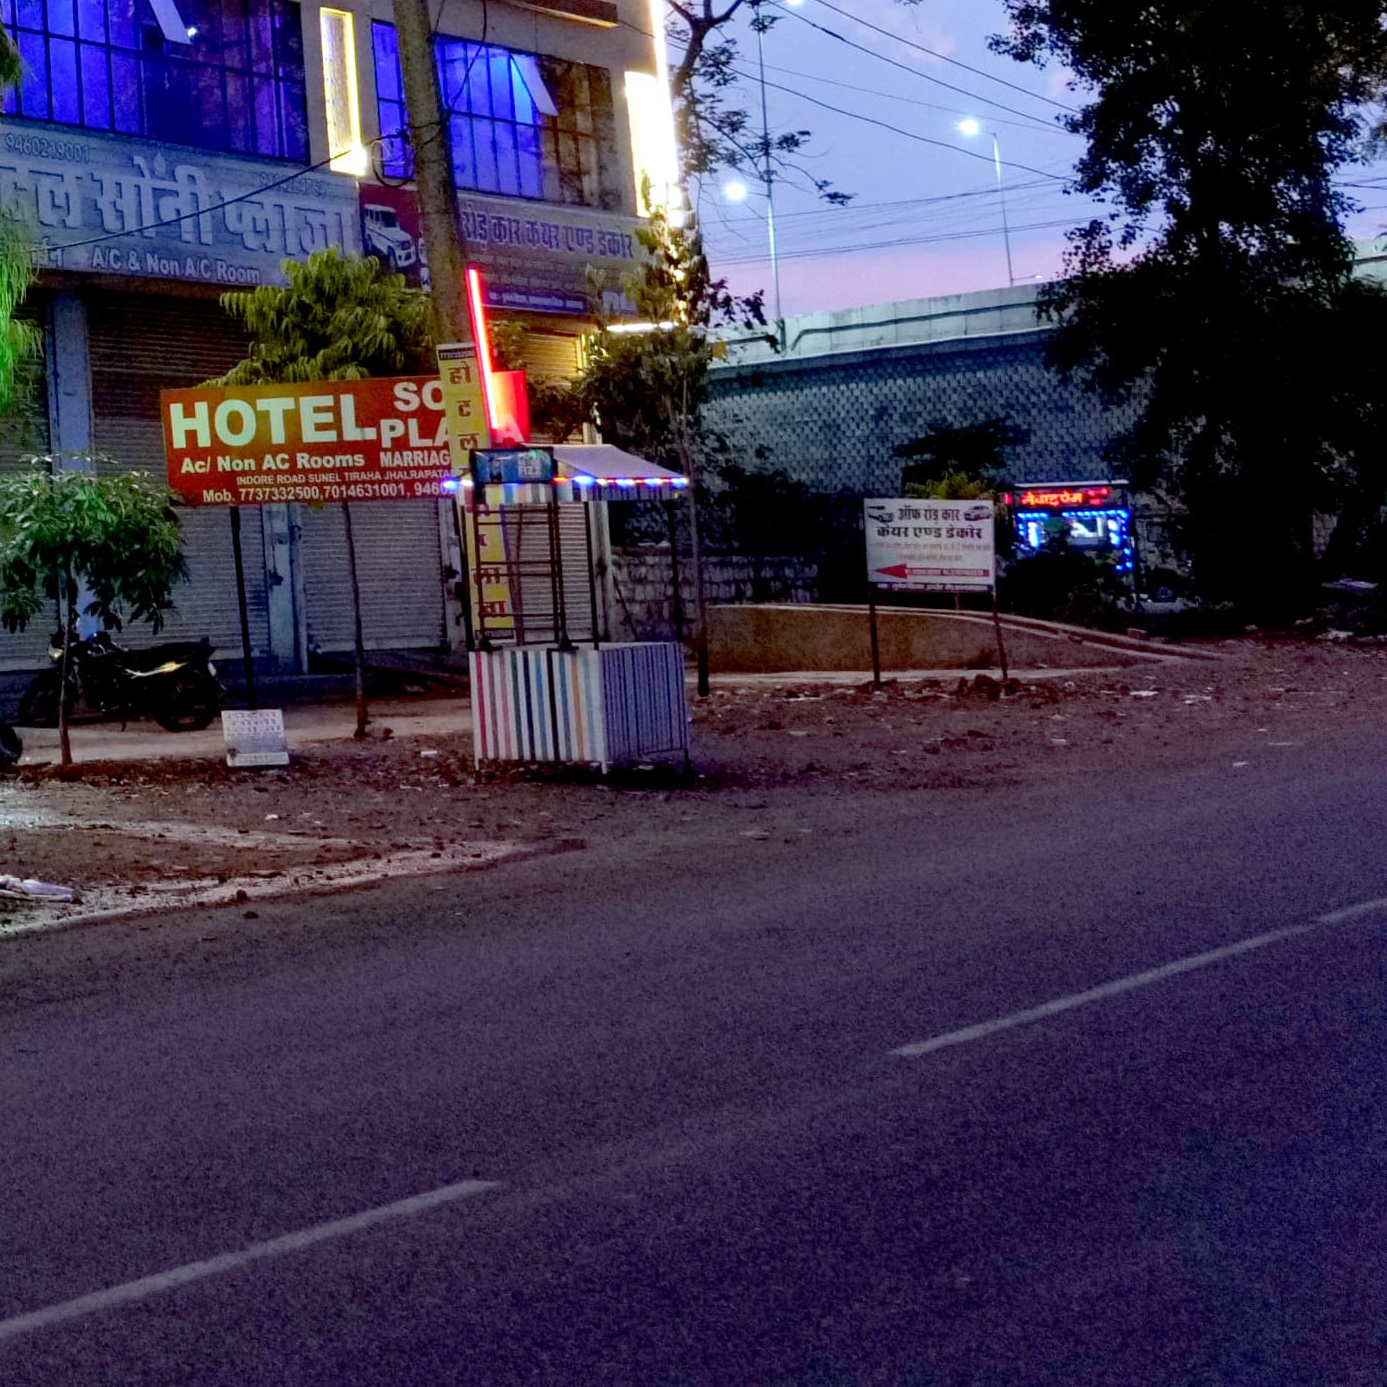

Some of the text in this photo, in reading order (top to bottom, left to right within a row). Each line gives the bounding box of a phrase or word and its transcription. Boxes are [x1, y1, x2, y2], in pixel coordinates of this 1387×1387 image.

[90, 155, 214, 246] सोनी
[92, 245, 122, 270] A/C
[129, 250, 141, 272] &
[146, 253, 180, 276] Non
[185, 260, 212, 280] A/C
[216, 262, 261, 285] Room
[169, 380, 446, 449] HOTEL SO
[181, 450, 450, 474] Ac/ Non AC Rooms MARRIAG
[236, 469, 452, 486] INDORE ROAD SUNEL TIRAHA JHALRAPATA
[203, 489, 235, 504] Mob.
